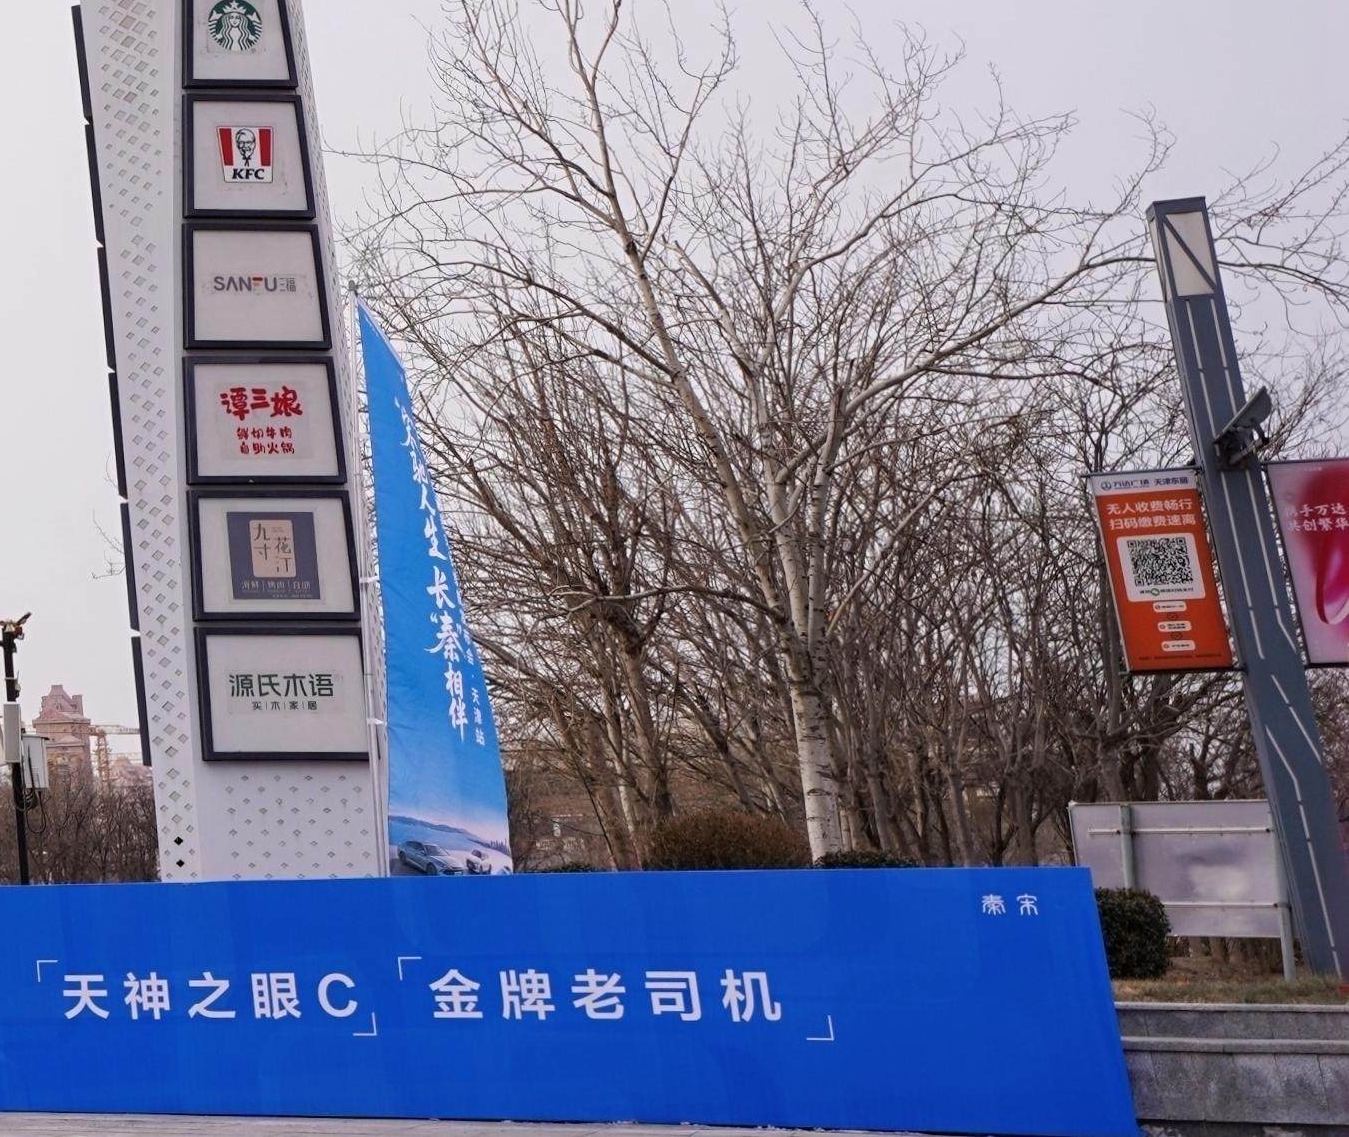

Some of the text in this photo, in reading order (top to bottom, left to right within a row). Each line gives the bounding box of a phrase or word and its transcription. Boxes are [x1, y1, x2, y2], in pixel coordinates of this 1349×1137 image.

[231, 168, 265, 180] KFC
[213, 275, 277, 292] SANFU
[219, 385, 303, 421] 谭三娘
[237, 426, 293, 440] 鲜切牛肉
[240, 441, 295, 455] 自助火锅
[1107, 498, 1193, 515] 无人收费畅行
[254, 522, 272, 561] 九寸
[229, 673, 334, 698] 源氏木语
[982, 893, 1039, 916] 秦 宋
